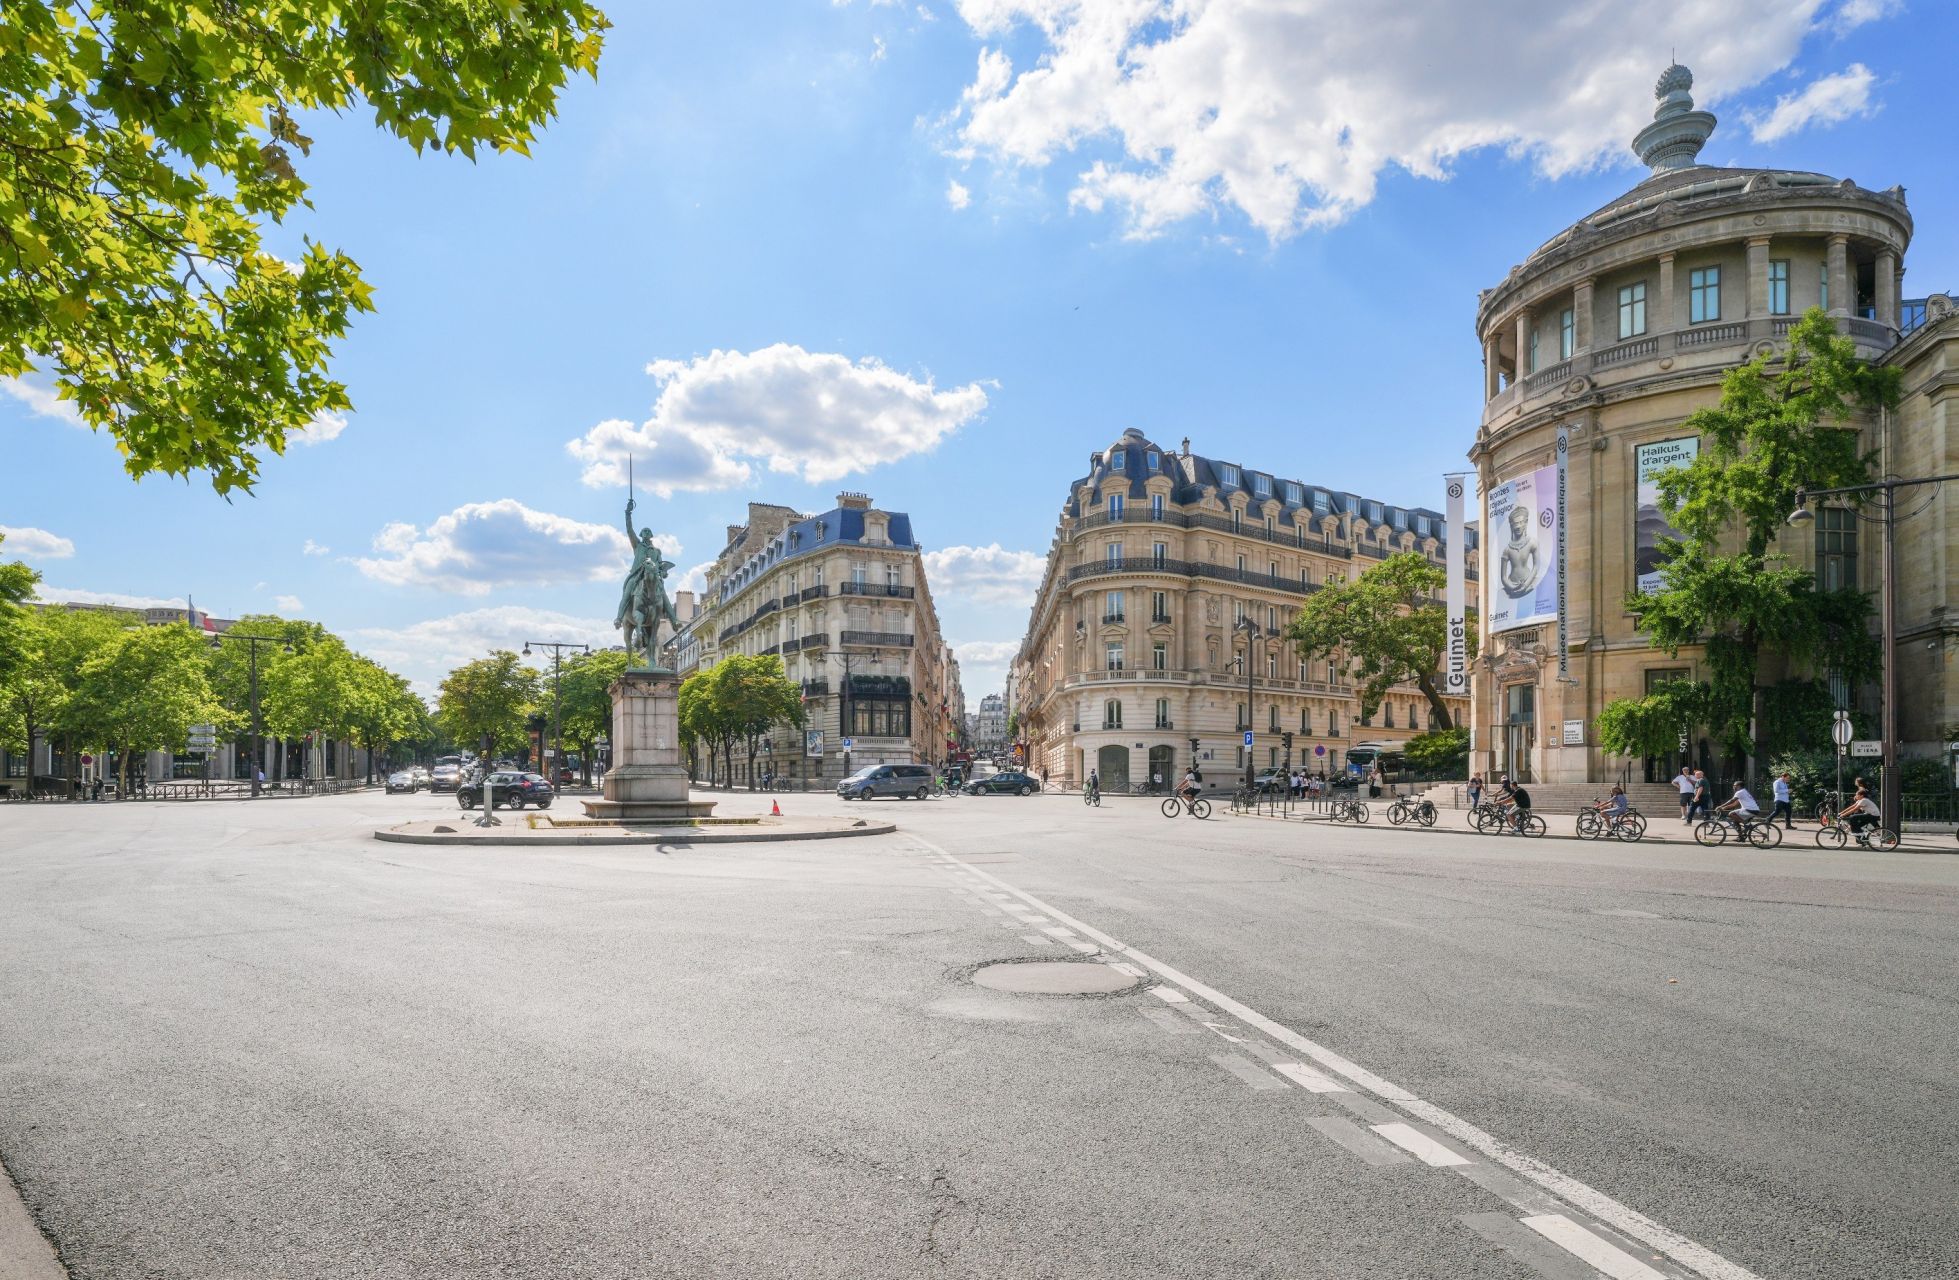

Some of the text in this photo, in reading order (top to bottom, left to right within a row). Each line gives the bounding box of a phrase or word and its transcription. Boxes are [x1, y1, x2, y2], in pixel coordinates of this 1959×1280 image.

[1642, 445, 1680, 456] Haïkus
[1642, 451, 1691, 465] d'argent
[1489, 487, 1509, 501] Bronzes
[1449, 617, 1464, 687] Guimet
